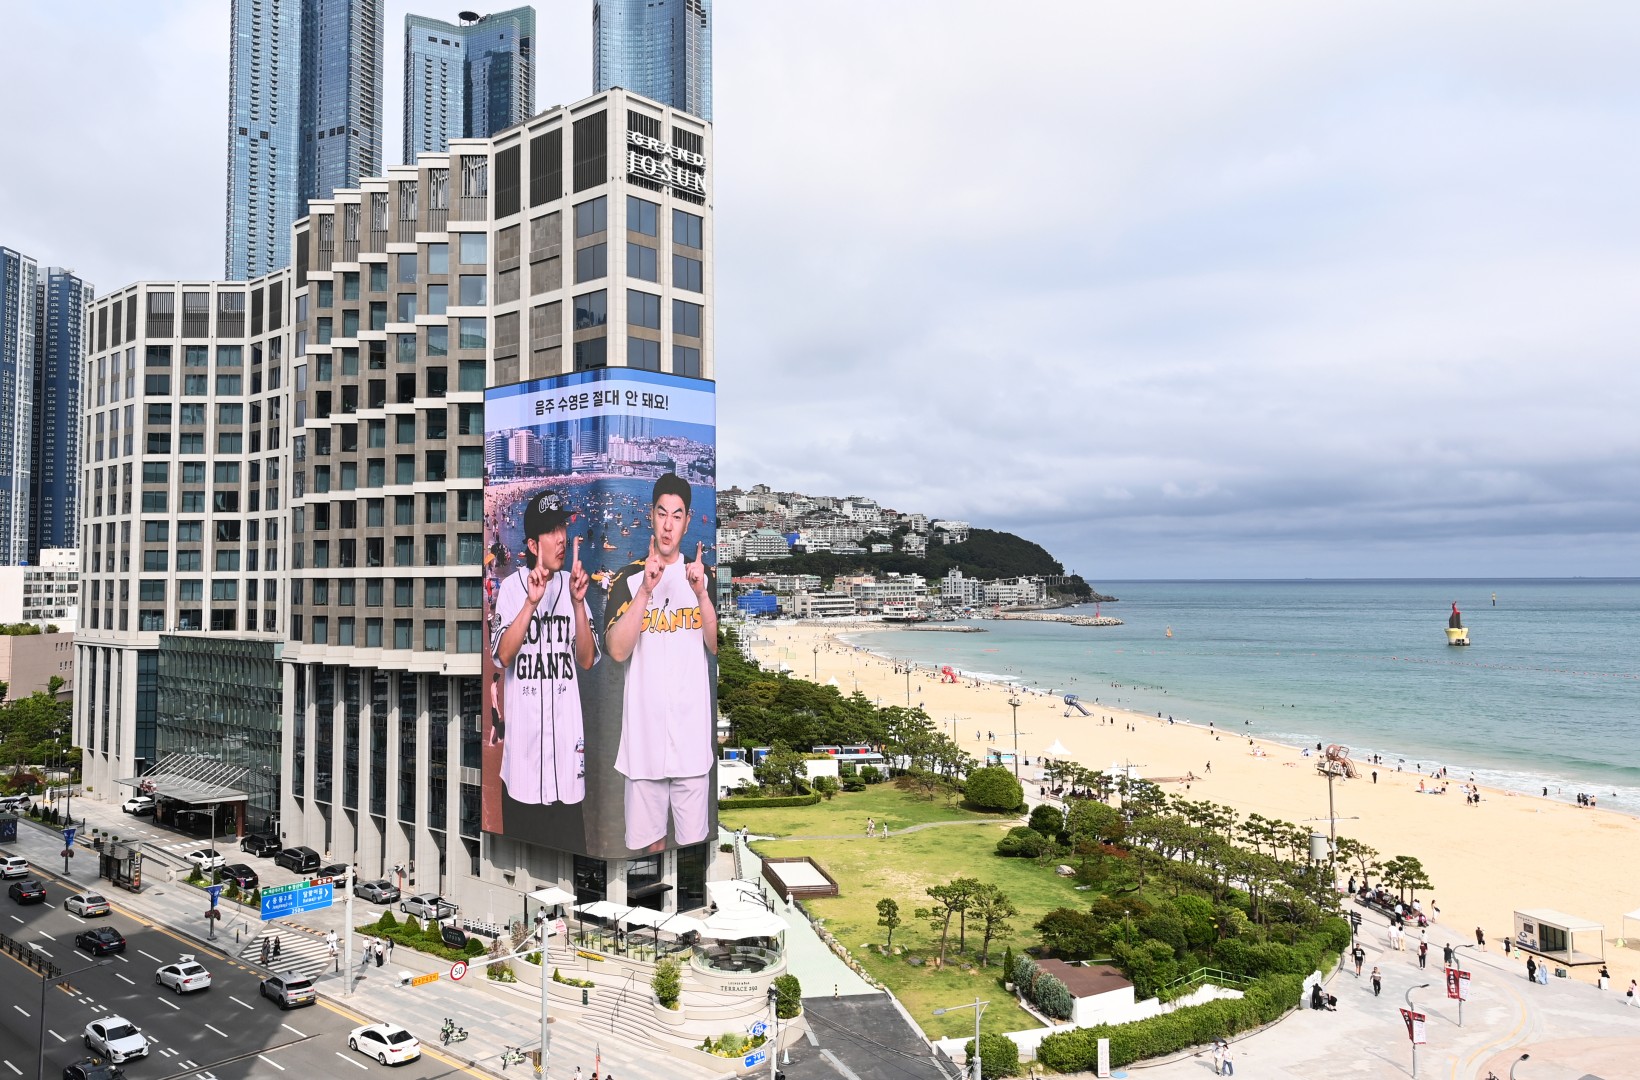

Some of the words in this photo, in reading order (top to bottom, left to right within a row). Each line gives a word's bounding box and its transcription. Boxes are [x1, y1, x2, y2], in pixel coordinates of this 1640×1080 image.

[631, 131, 705, 167] GRAND
[627, 150, 707, 196] JOSUN
[535, 399, 555, 416] 음주
[558, 392, 589, 413] 수영은
[592, 389, 620, 408] 절대
[625, 390, 638, 407] 안
[641, 392, 669, 411] 돼요!
[516, 652, 574, 680] GIANTS
[454, 966, 463, 976] 50
